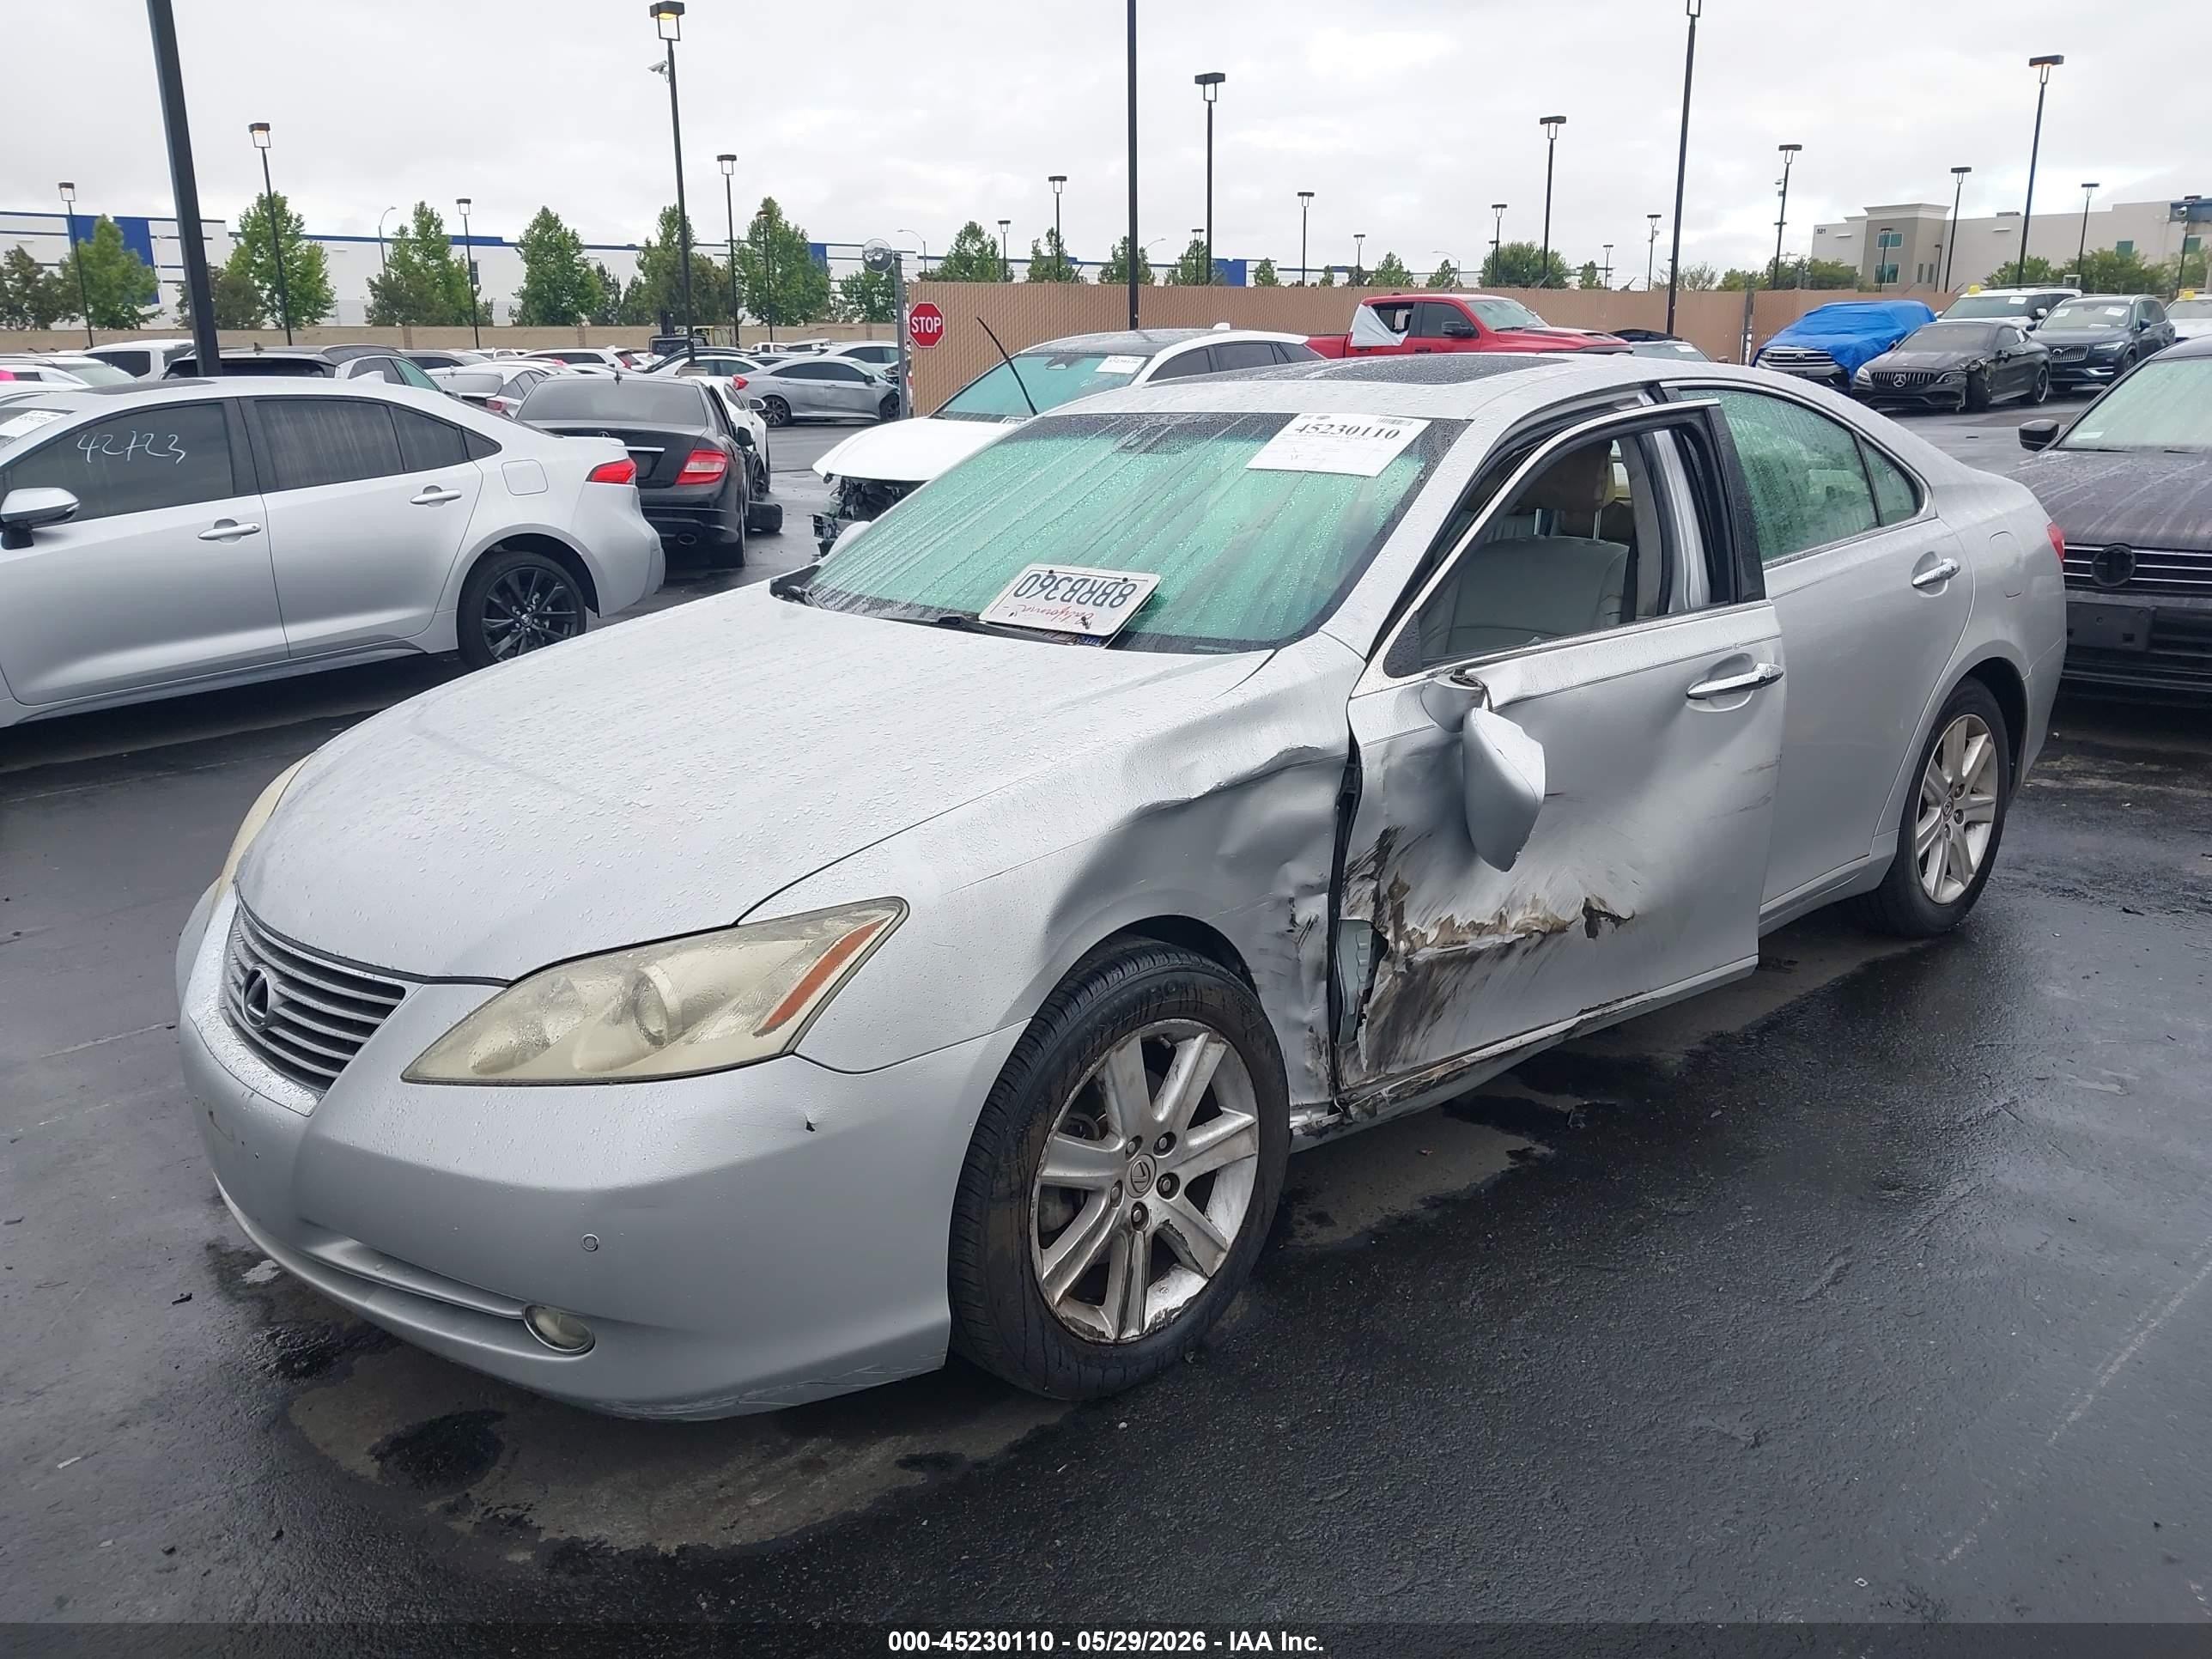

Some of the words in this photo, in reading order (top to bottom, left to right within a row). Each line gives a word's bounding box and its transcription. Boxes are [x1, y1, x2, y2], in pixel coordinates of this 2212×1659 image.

[911, 316, 942, 333] STOP
[1293, 422, 1401, 441] 45230110
[76, 429, 187, 465] 42723
[1012, 573, 1138, 609] 8BRB360
[1018, 604, 1095, 624] California
